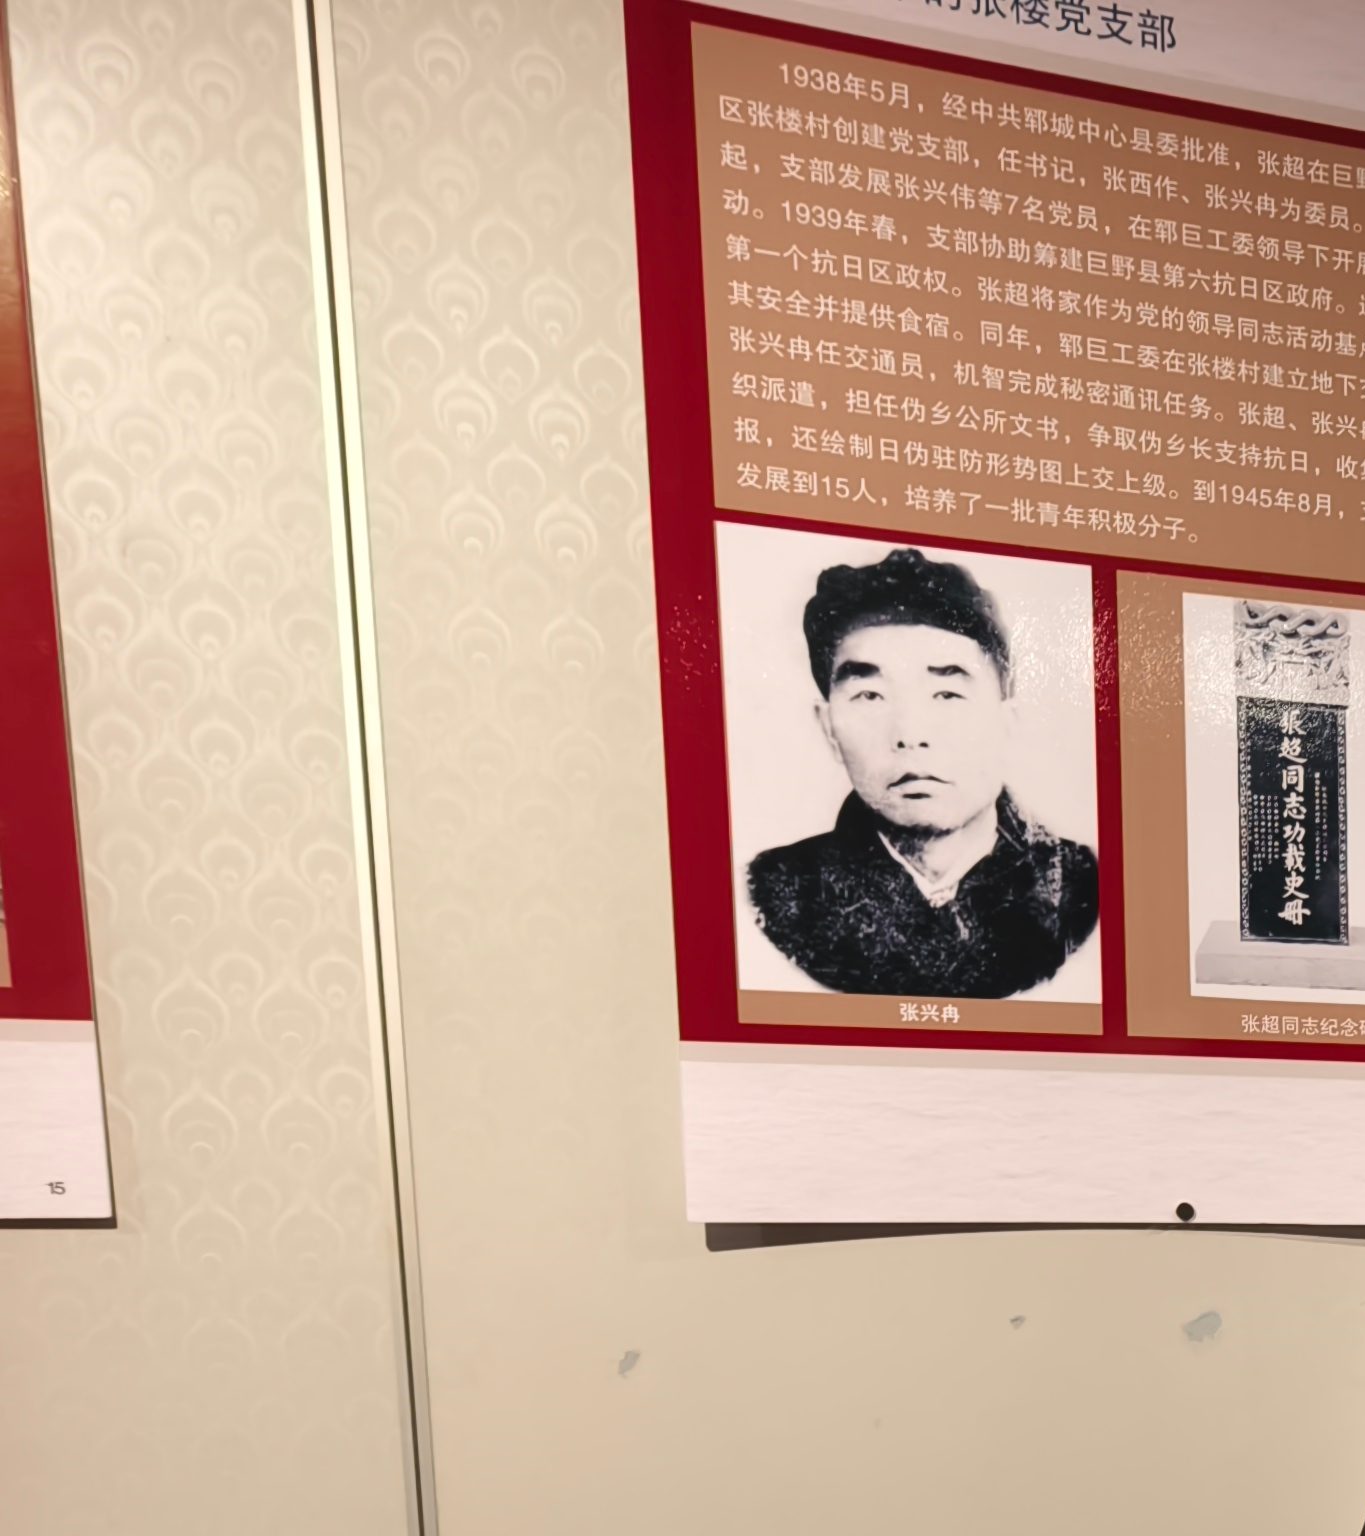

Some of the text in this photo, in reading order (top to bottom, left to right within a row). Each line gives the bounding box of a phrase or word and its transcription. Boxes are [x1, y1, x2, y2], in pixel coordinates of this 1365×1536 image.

[736, 462, 1201, 545] 发展到15人，培养了一批青年积极分子。
[899, 1003, 961, 1024] 张兴冉
[45, 1181, 66, 1195] 15
